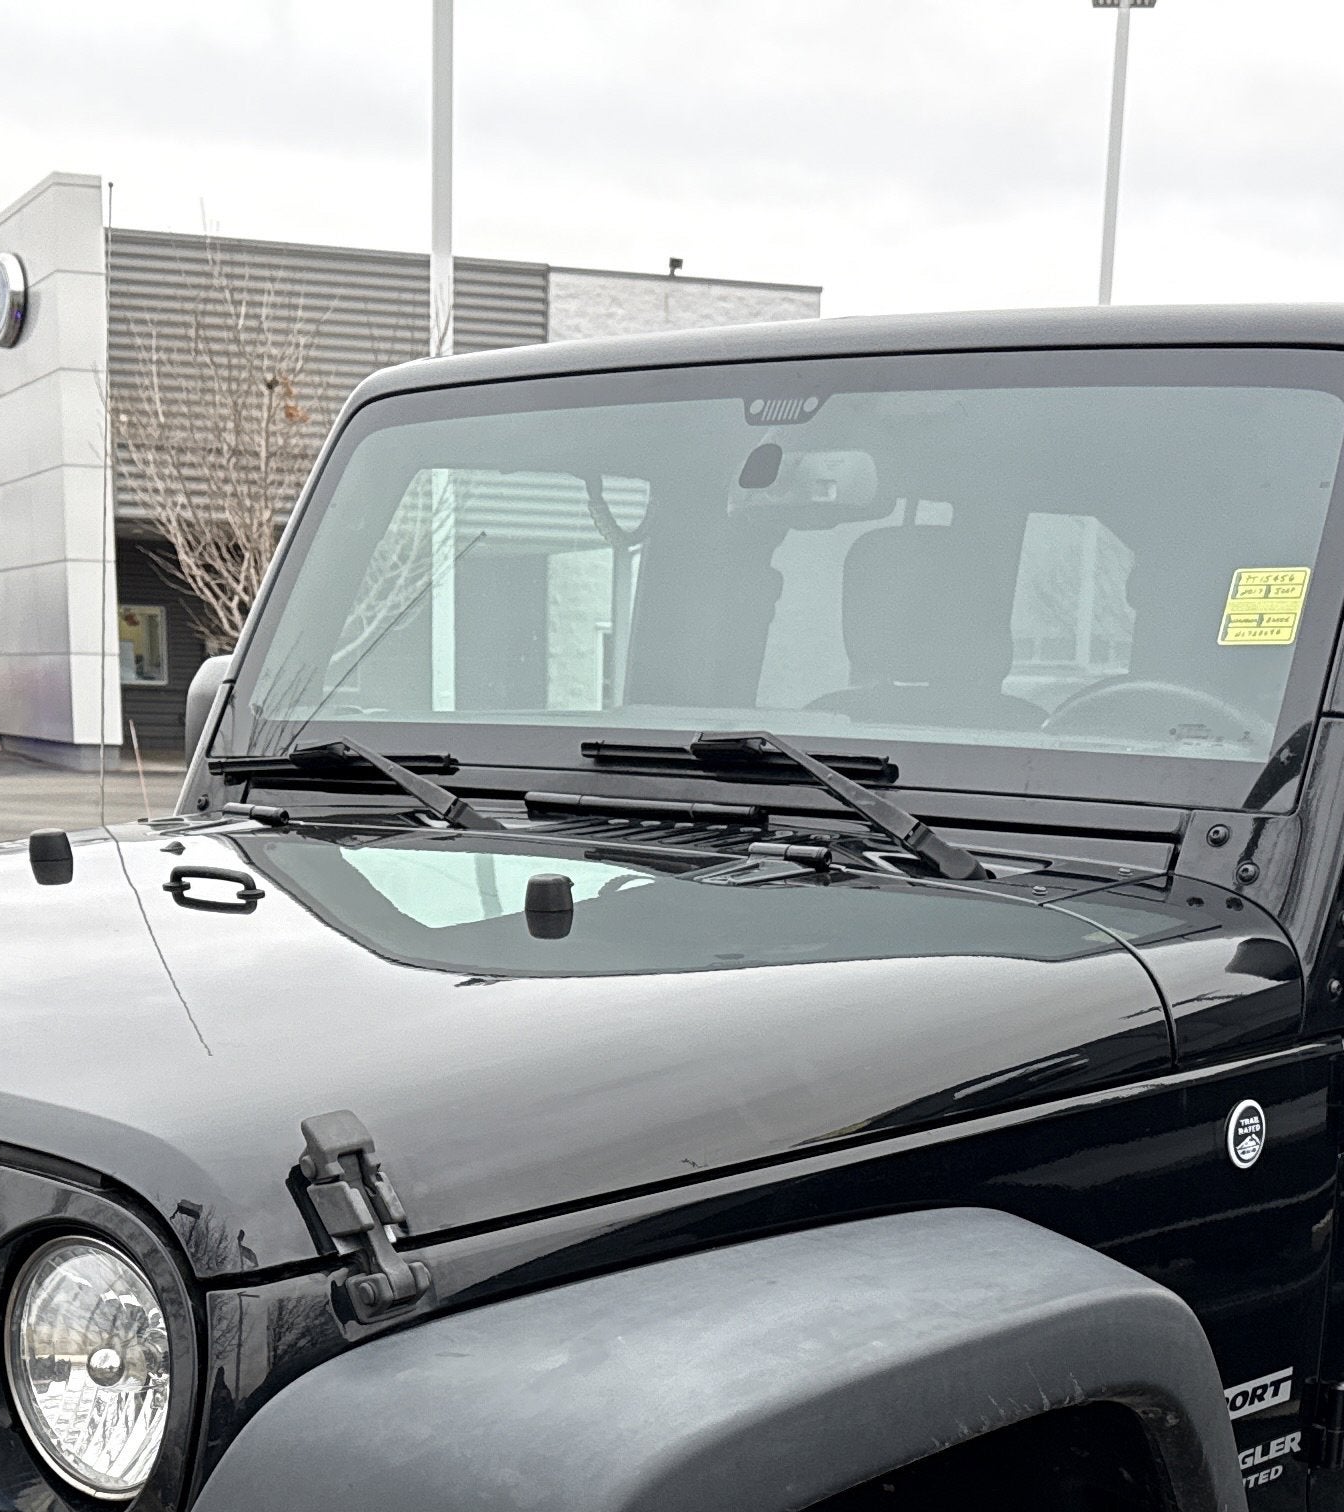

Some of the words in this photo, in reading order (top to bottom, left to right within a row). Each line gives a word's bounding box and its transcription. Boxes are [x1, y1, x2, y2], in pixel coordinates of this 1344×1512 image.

[1239, 1116, 1260, 1126] TRAIL
[1238, 1124, 1261, 1135] RATED
[1225, 1379, 1292, 1412] ORT
